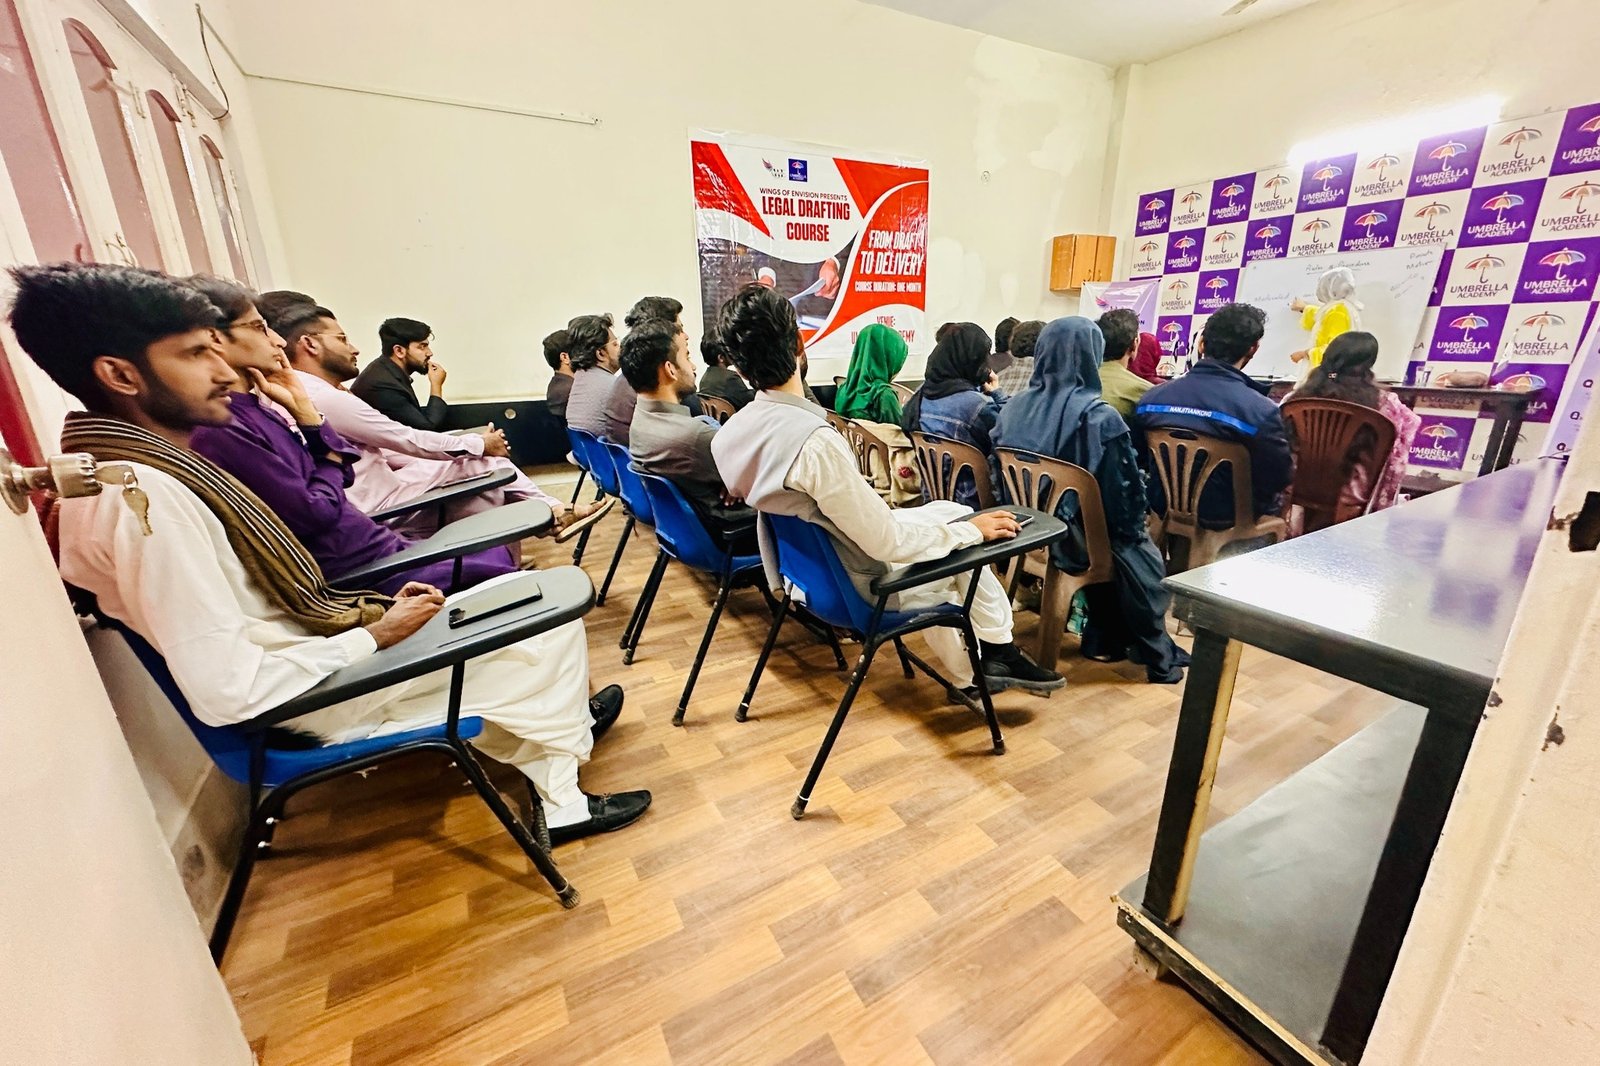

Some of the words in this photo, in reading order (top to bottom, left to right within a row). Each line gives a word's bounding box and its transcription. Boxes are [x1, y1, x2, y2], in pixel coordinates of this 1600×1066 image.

[1562, 146, 1600, 160] UMBR
[1482, 156, 1546, 172] UMBRELLA
[1416, 168, 1468, 183] UMBRELLA
[1490, 166, 1534, 178] ACADEMY
[1354, 179, 1404, 194] UMBRELLA
[1422, 177, 1460, 188] ACADEMY
[760, 188, 780, 196] WINGS
[792, 190, 819, 199] ENVISION
[820, 193, 848, 201] PRESENTS
[1302, 188, 1344, 201] UMBRELLA
[1360, 188, 1394, 198] ACADEMY
[1254, 197, 1293, 209] UMBRELLA
[1308, 197, 1336, 205] ACADEMY
[762, 196, 796, 217] LEGAL
[798, 198, 850, 220] DRAFTING
[1212, 204, 1246, 216] UMBRELLA
[1138, 217, 1167, 227] UMBRELLA
[1174, 212, 1205, 222] UMBRELLA
[786, 222, 830, 242] COURSE
[1468, 220, 1526, 234] UMBRELLA
[1549, 222, 1598, 232] ACADEMY
[1400, 229, 1454, 242] UMBRELLA
[1474, 230, 1516, 239] ACADEMY
[869, 230, 892, 249] FROM
[893, 231, 918, 251] DRAFT
[1344, 236, 1389, 246] UMBRELLA
[1408, 238, 1444, 246] ACADEMY
[1247, 247, 1284, 256] UMBRELLA
[1292, 242, 1334, 252] UMBRELLA
[1350, 244, 1382, 252] ACADEMY
[1168, 256, 1198, 265] UMBRELLA
[1205, 252, 1239, 262] UMBRELLA
[860, 250, 874, 275] TO
[874, 252, 924, 276] DELIVERY
[1134, 260, 1162, 268] UMBRELLA
[1450, 283, 1509, 294] UMBRELLA
[1524, 278, 1588, 290] UMBRELLA
[1162, 300, 1192, 308] UMBRELLA
[1436, 341, 1490, 350] UMBRELLA
[1409, 446, 1460, 459] UMBRELLA
